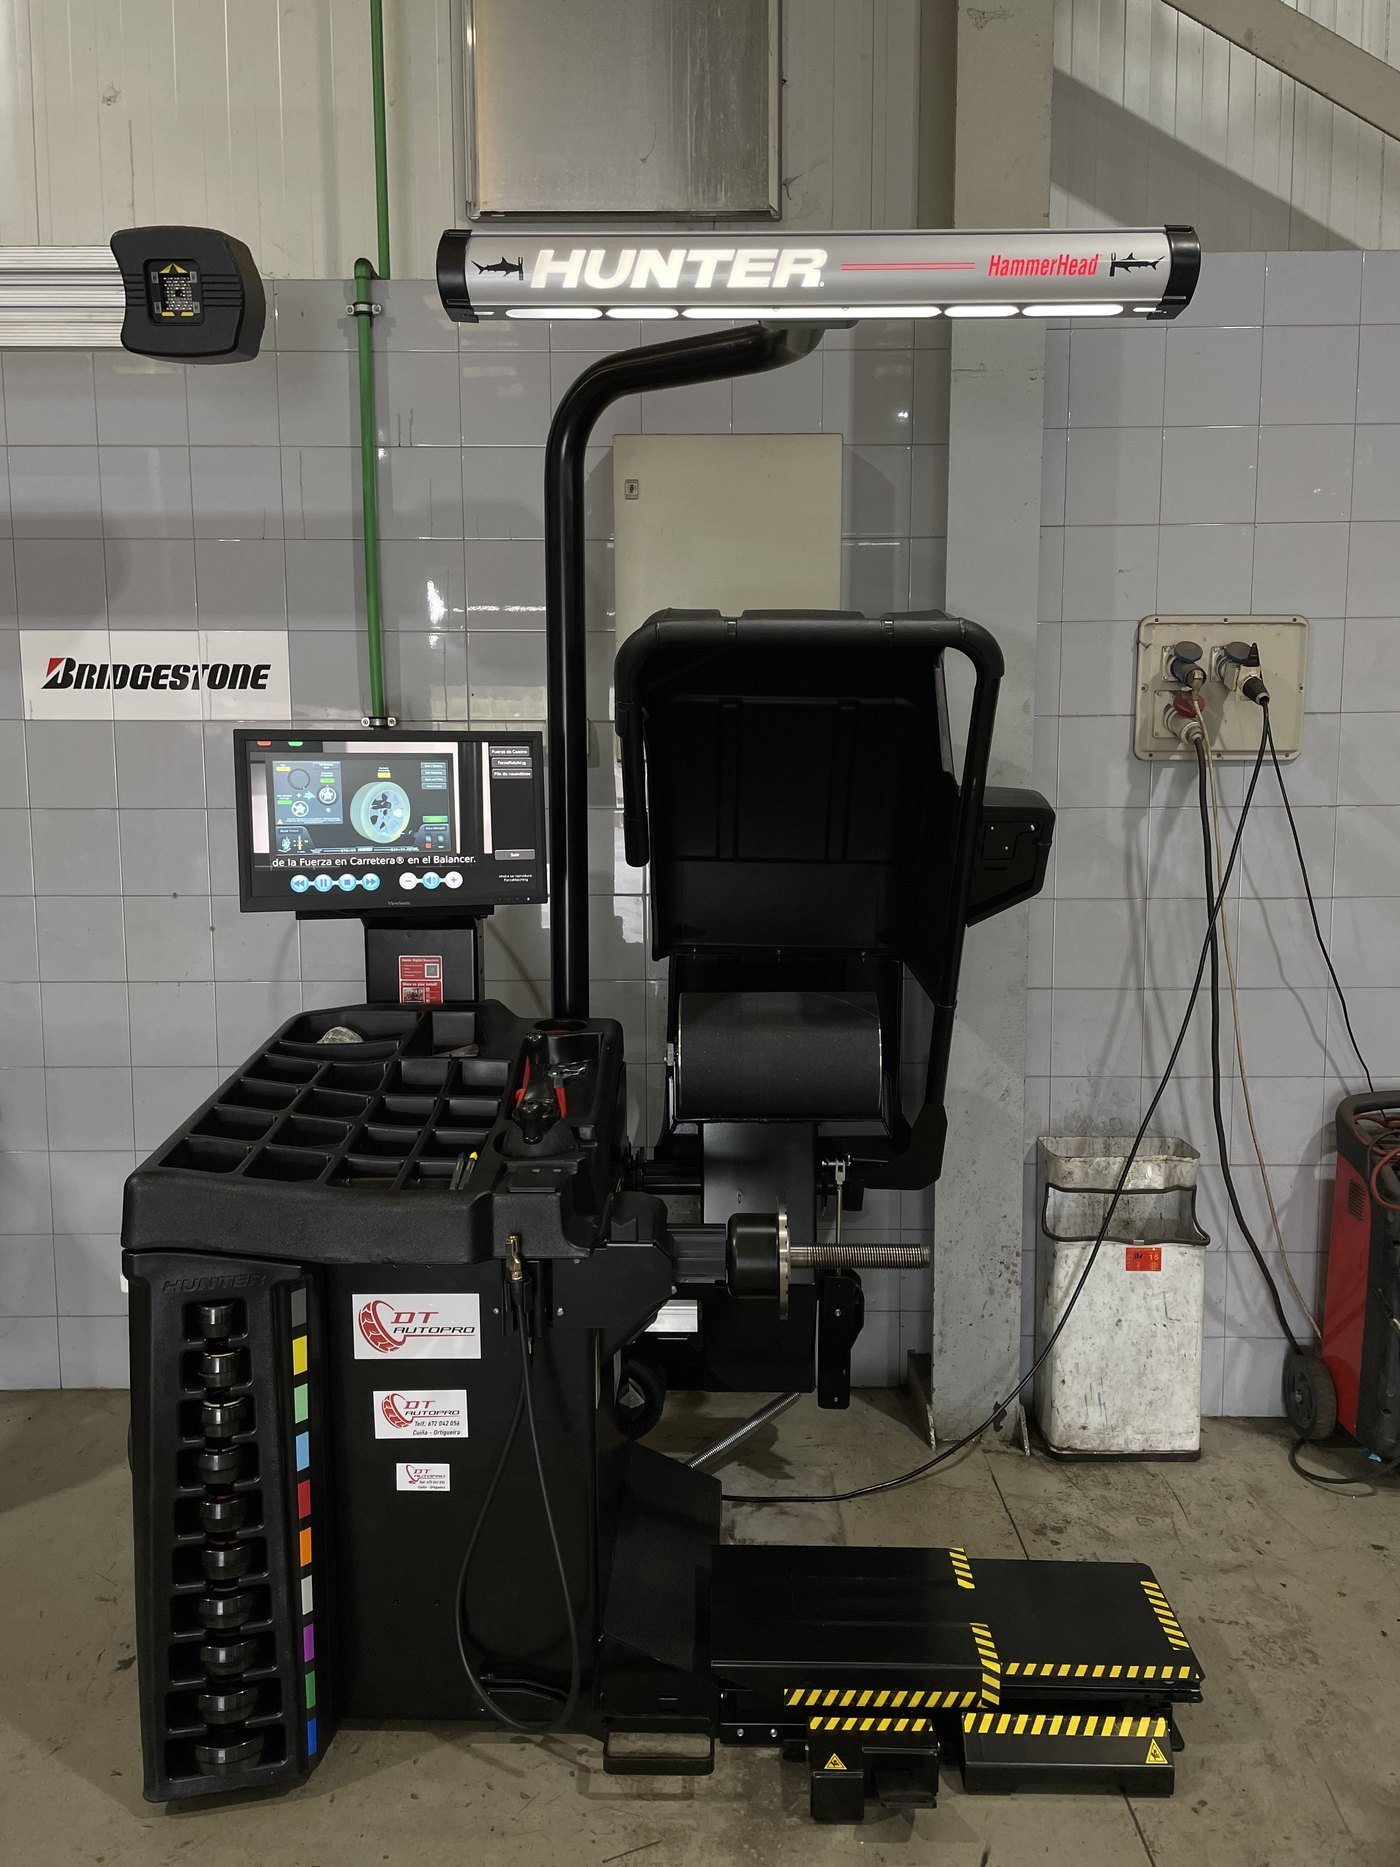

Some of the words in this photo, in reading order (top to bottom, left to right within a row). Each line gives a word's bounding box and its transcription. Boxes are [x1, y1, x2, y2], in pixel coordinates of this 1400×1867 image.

[530, 248, 827, 289] HUNTER
[988, 253, 1099, 277] HammerHead
[41, 657, 271, 690] BRIDGESTONE
[272, 858, 285, 867] de
[287, 858, 296, 867] la
[299, 857, 332, 867] Fuerza
[335, 858, 347, 866] en
[407, 856, 420, 865] en
[422, 855, 431, 864] el
[433, 855, 476, 864] Balancer.
[162, 1274, 267, 1293] HUNTER
[391, 1311, 439, 1324] DT
[393, 1326, 476, 1334] AUTOPRO
[403, 1400, 436, 1410] DT
